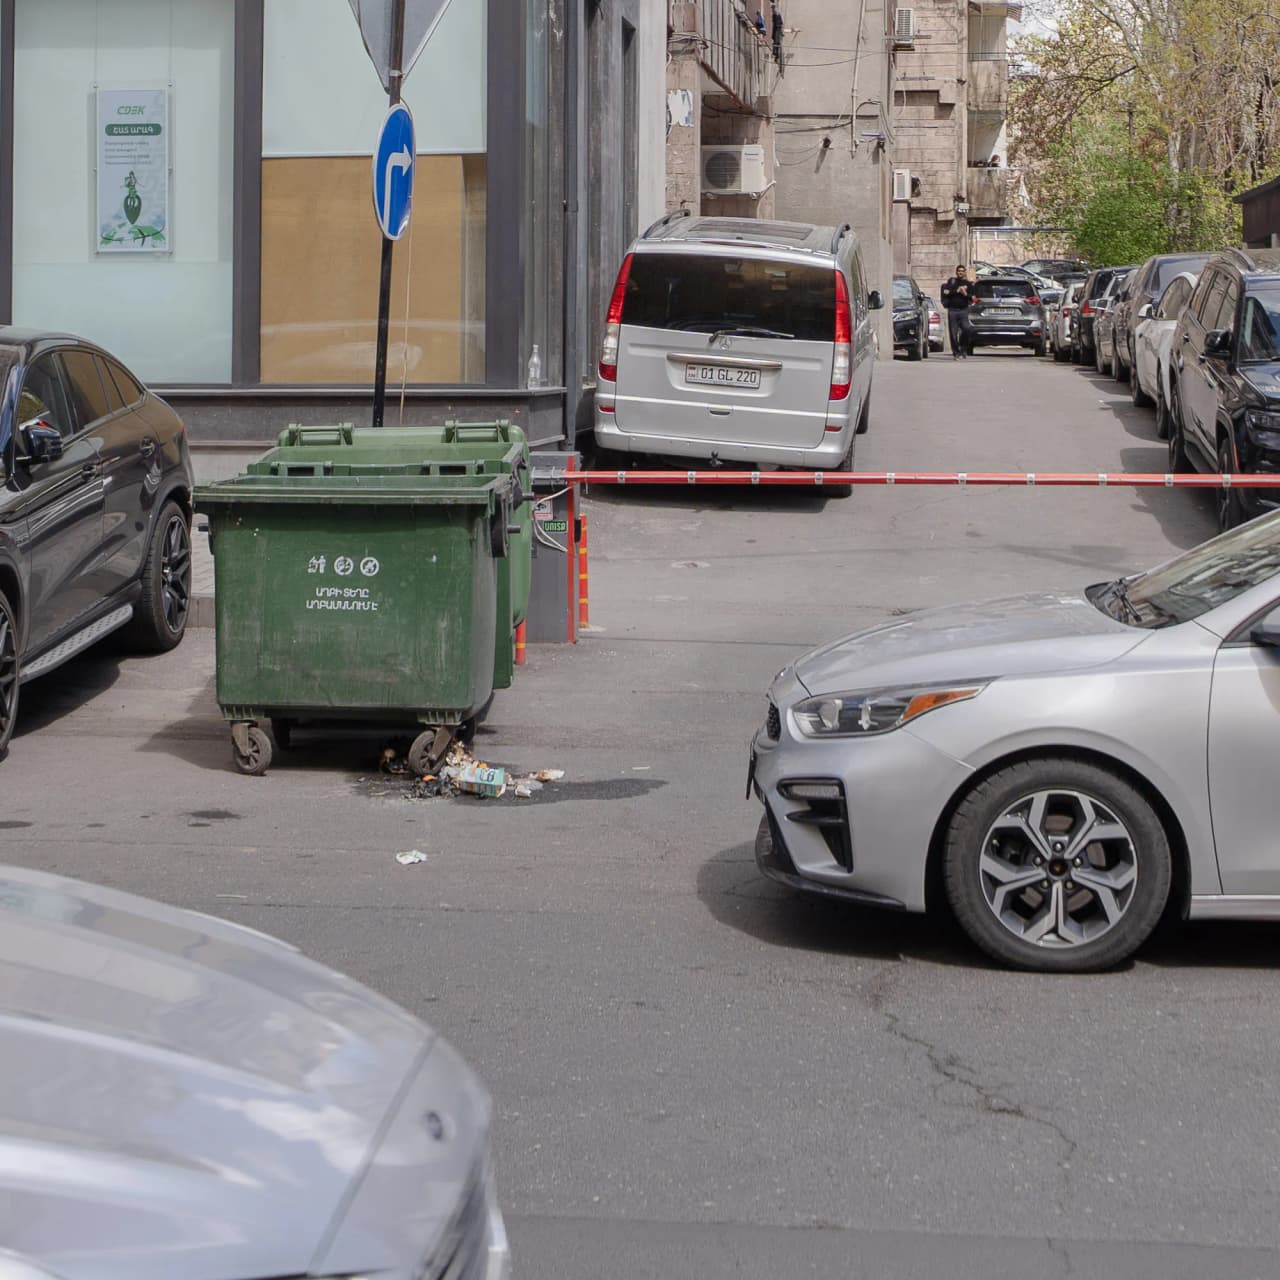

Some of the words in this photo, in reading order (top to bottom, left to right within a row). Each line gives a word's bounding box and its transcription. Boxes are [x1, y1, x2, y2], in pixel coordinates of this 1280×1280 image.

[117, 105, 146, 116] CDEK
[701, 367, 714, 380] 01
[717, 368, 733, 381] GL
[736, 370, 757, 384] 220
[315, 587, 343, 597] ԱՂԲԻ
[343, 588, 370, 598] ՏԵՂԸ
